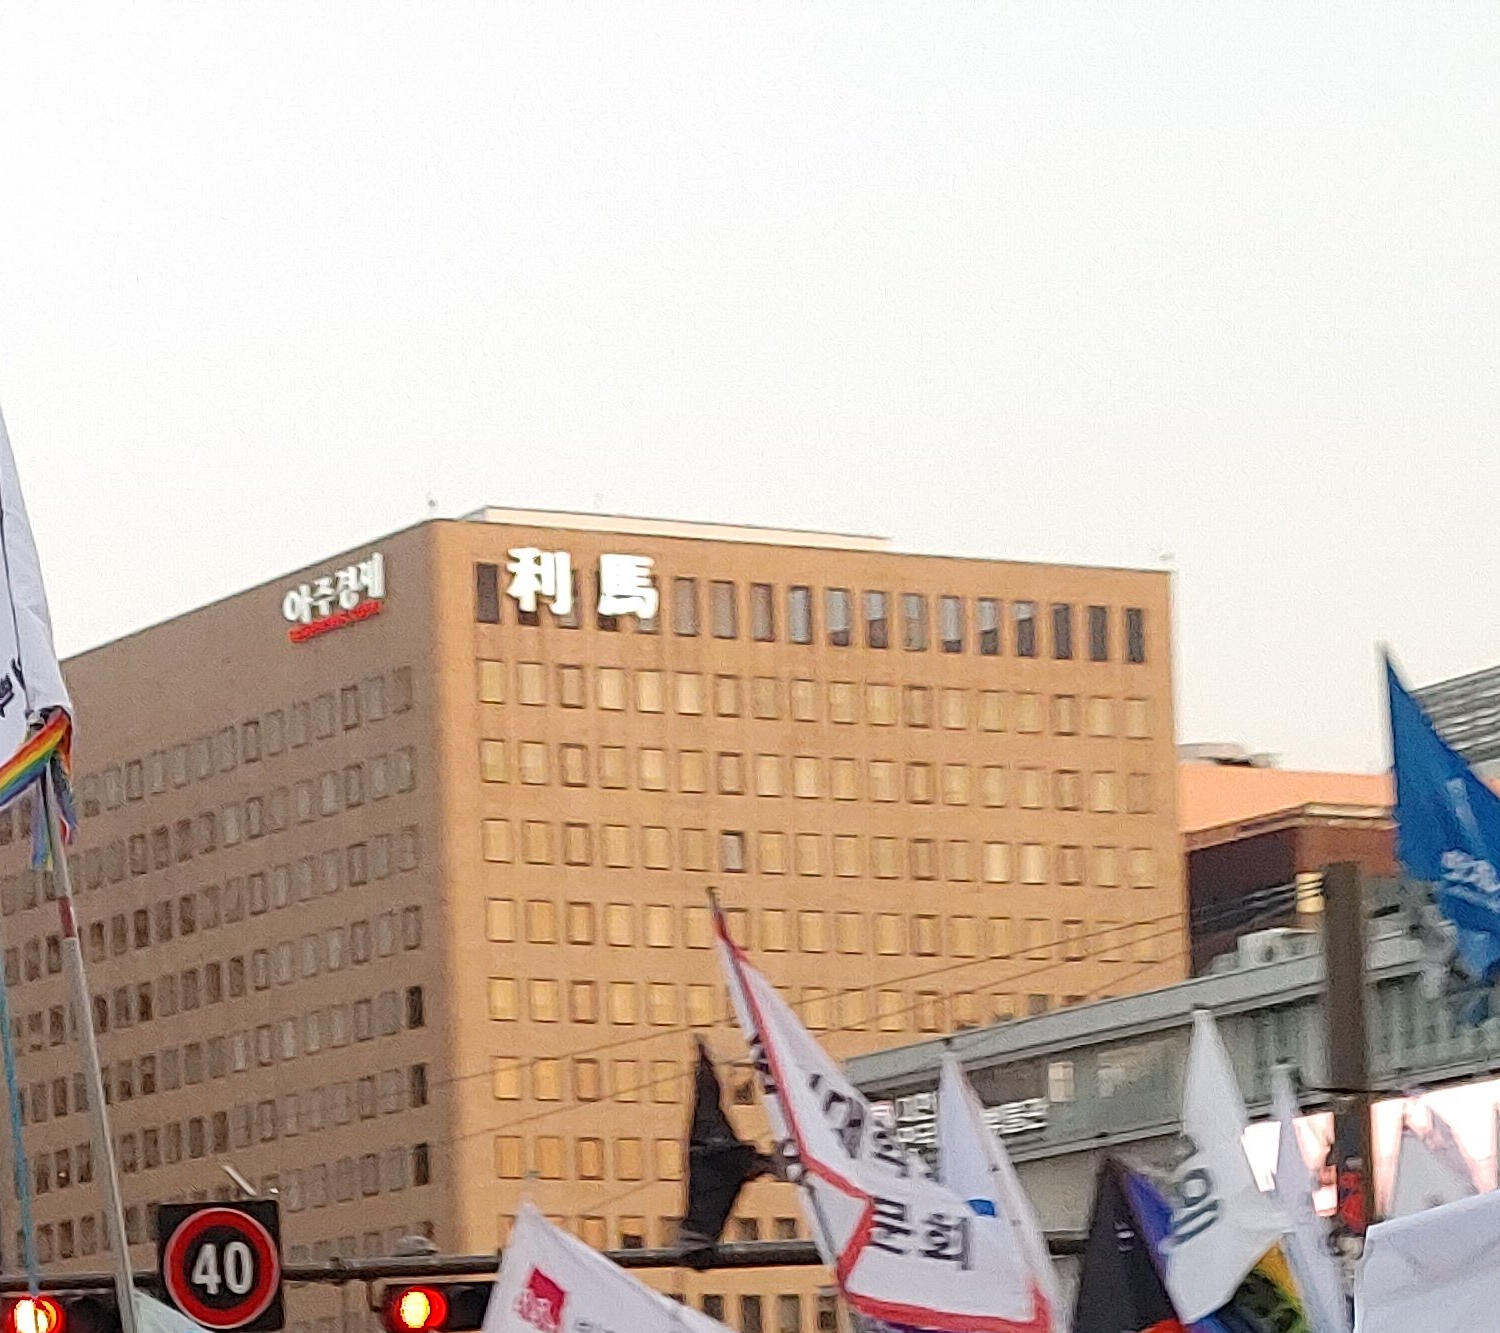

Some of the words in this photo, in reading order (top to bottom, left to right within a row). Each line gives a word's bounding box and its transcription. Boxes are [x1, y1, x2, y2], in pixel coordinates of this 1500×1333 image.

[283, 552, 386, 624] 아주경제
[505, 546, 660, 620] 利馬
[191, 1241, 254, 1296] 40
